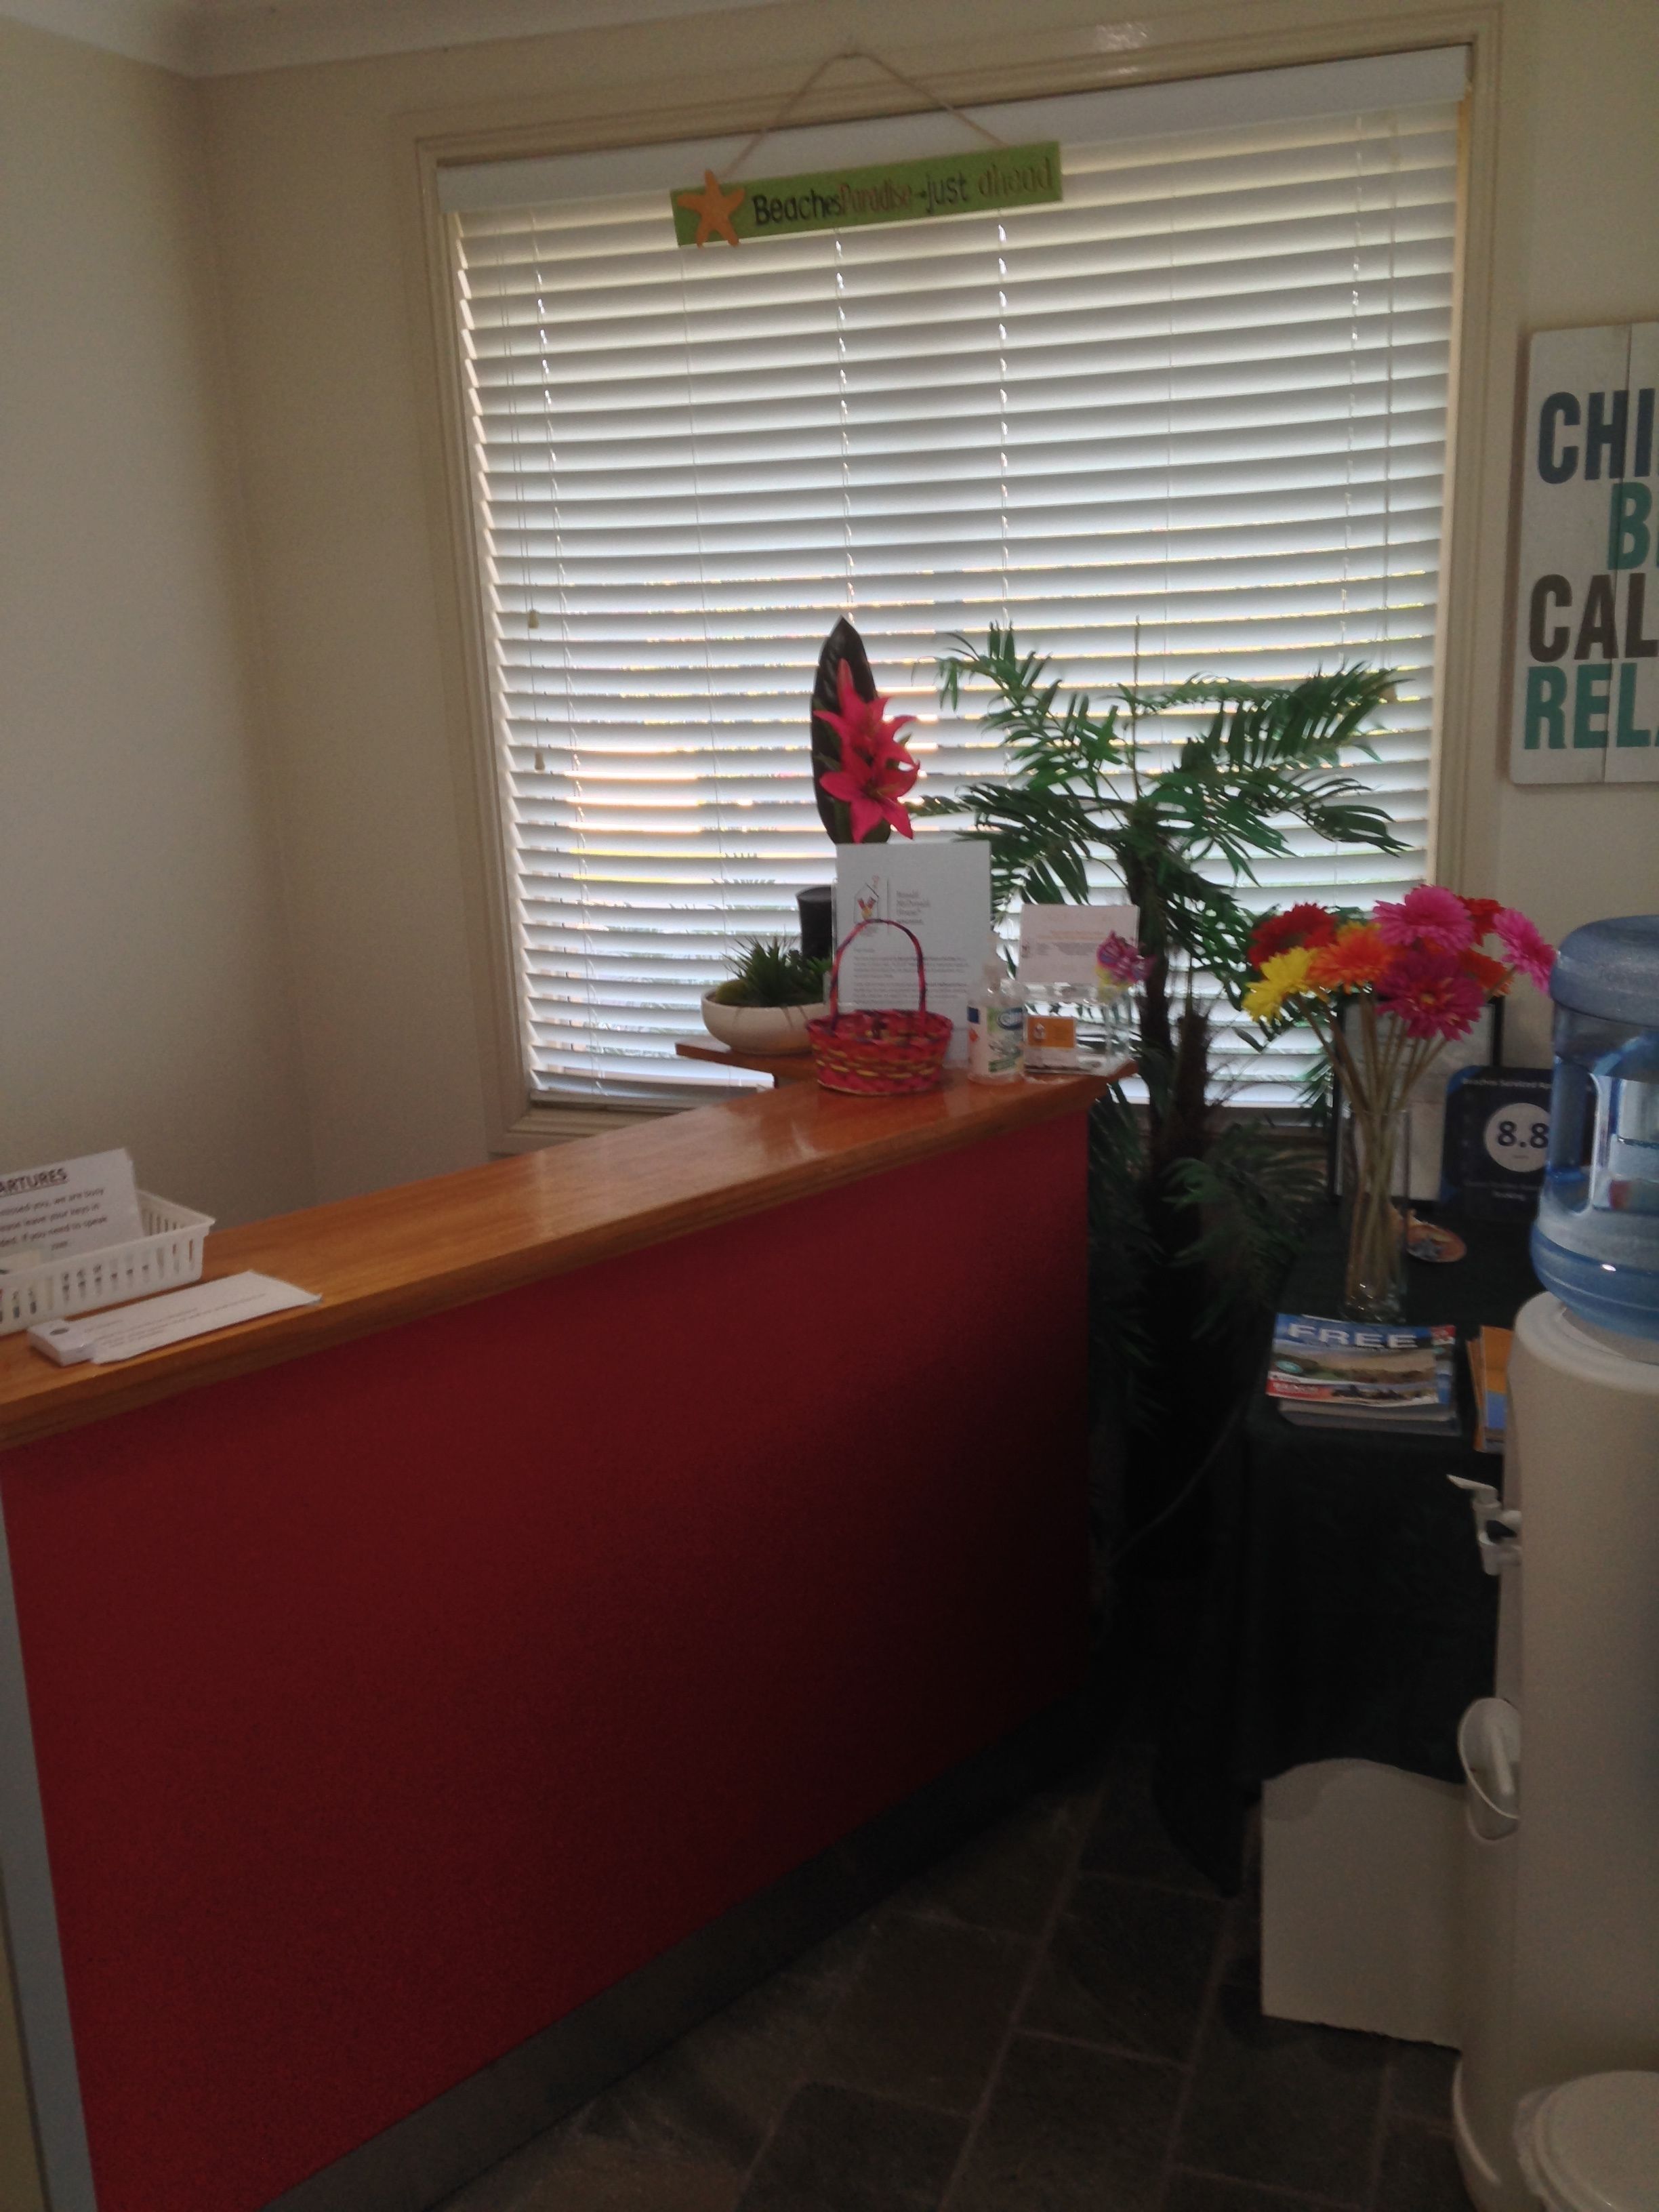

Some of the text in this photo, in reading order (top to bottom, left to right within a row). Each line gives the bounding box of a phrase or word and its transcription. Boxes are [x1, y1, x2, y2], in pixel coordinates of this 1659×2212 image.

[978, 157, 1054, 197] ahead
[1538, 388, 1659, 484] CHI
[1607, 482, 1659, 570] B
[1523, 662, 1659, 750] REL
[1498, 1120, 1549, 1149] 8.8
[1288, 1323, 1418, 1348] FREE
